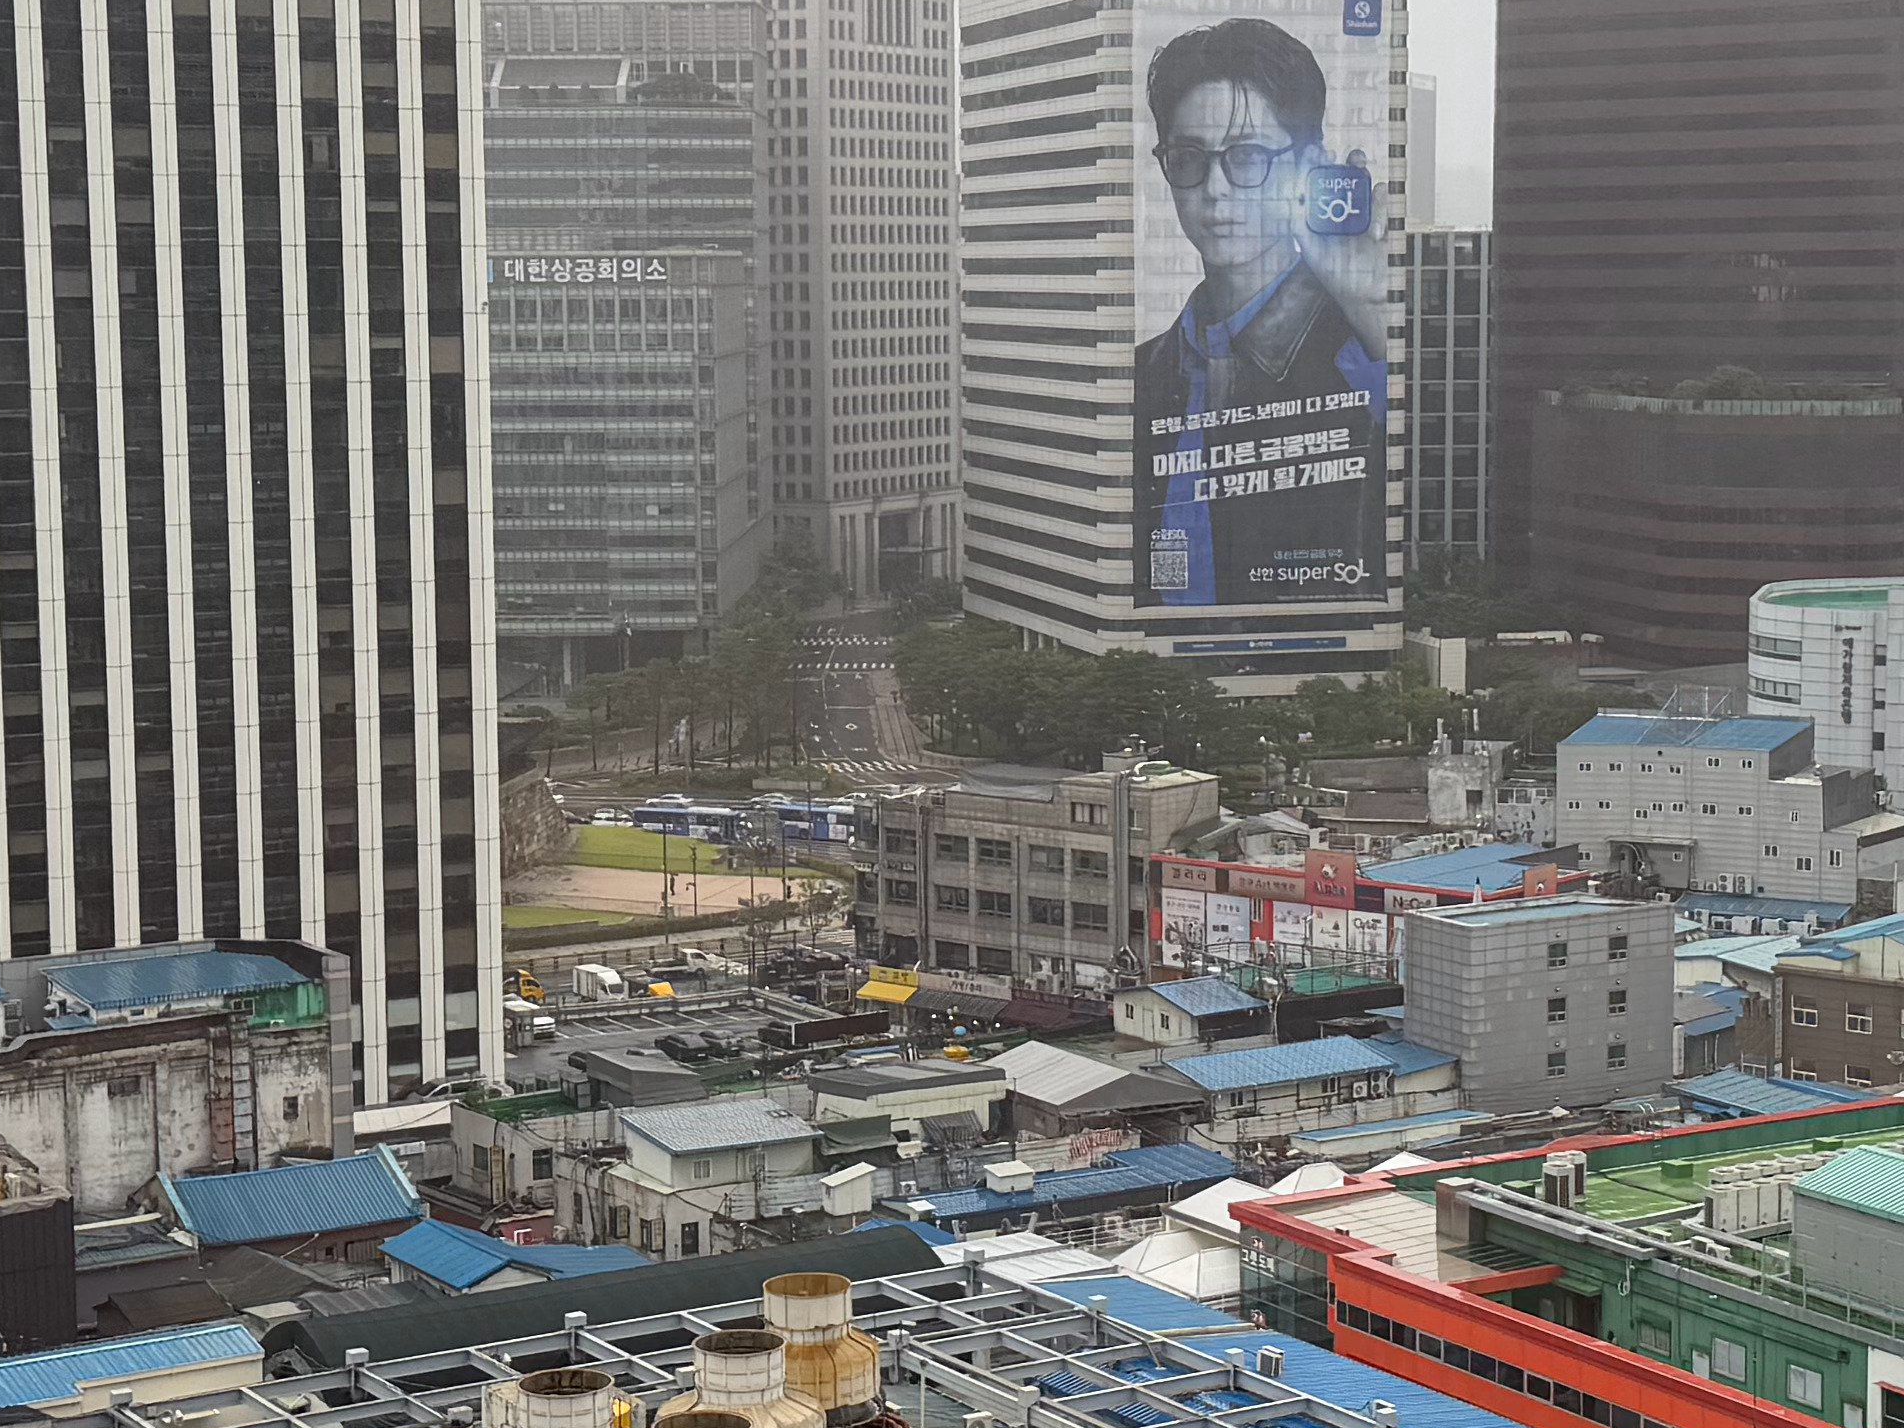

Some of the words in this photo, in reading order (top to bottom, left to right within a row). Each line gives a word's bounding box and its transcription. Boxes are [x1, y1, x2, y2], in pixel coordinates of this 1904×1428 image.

[1318, 177, 1359, 193] super
[504, 257, 668, 283] 대한상공회의소
[1248, 567, 1274, 582] 신한
[1277, 565, 1332, 585] super
